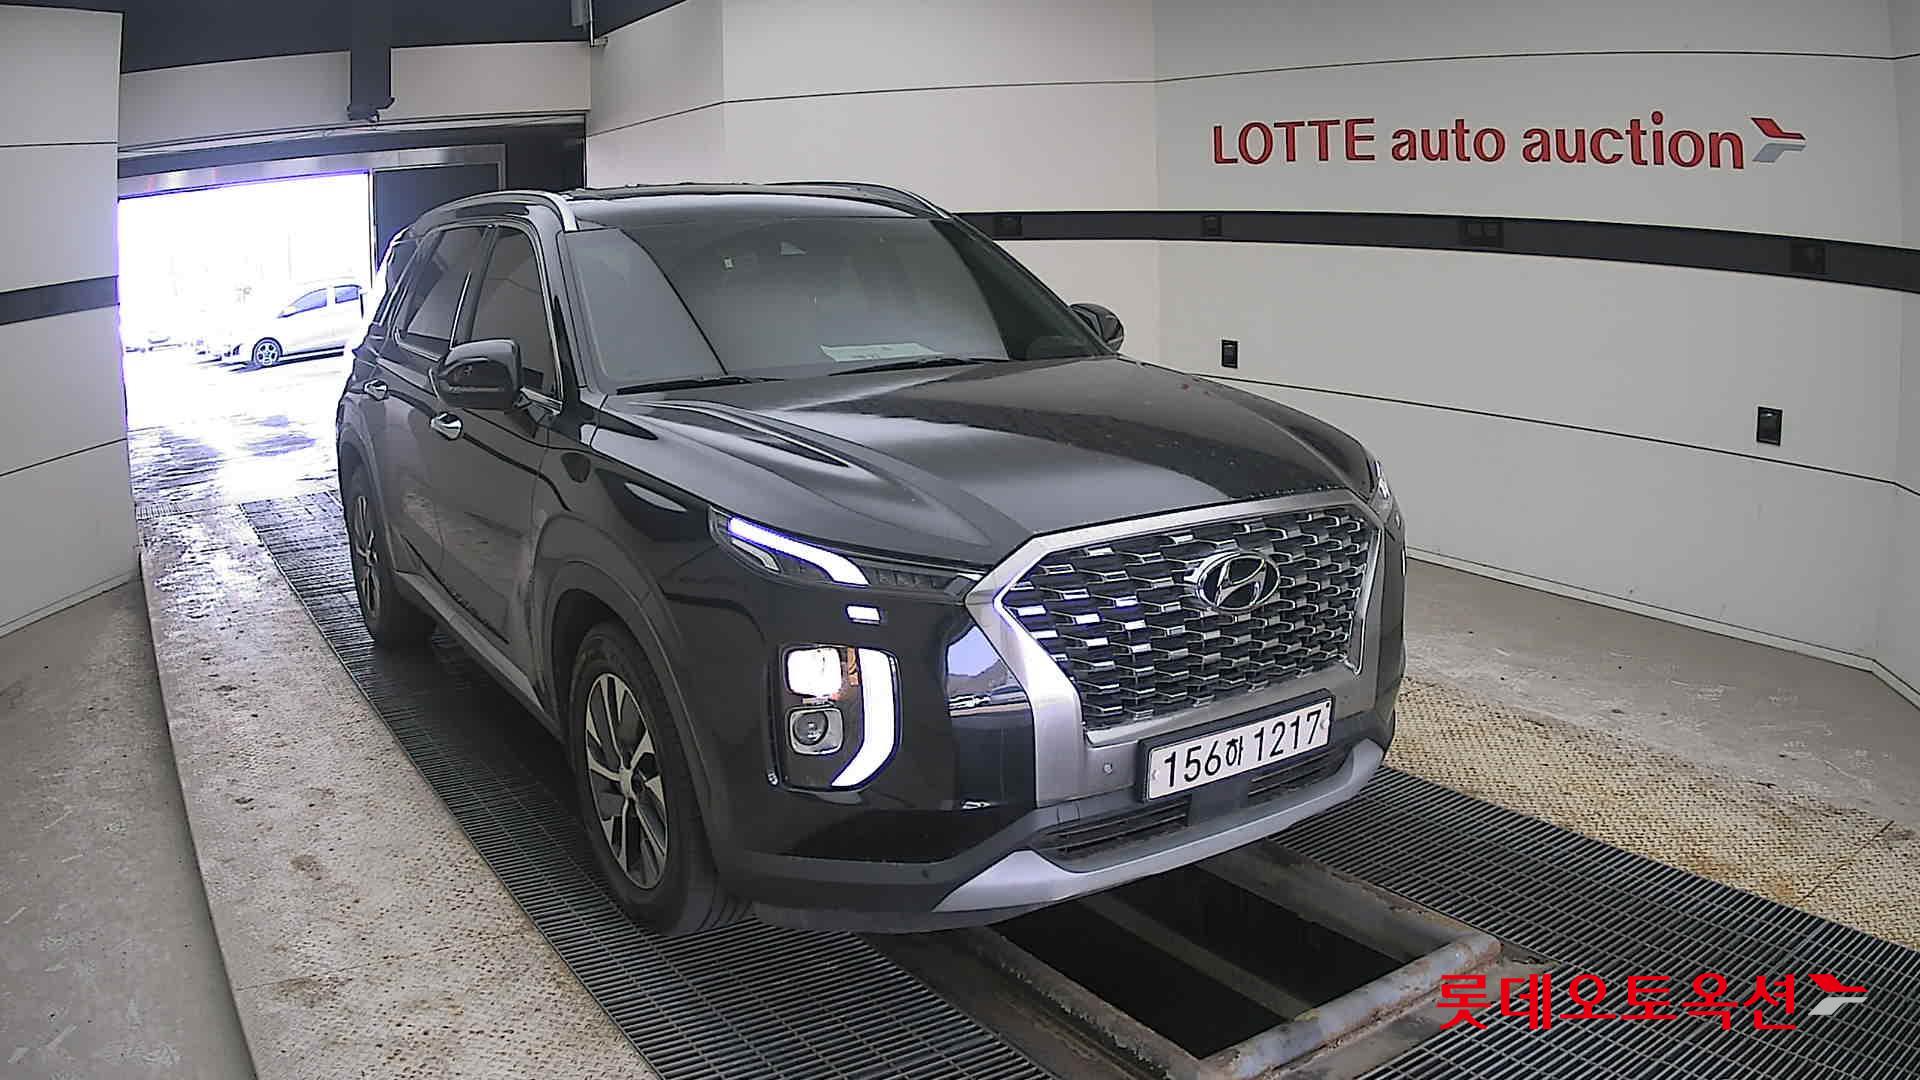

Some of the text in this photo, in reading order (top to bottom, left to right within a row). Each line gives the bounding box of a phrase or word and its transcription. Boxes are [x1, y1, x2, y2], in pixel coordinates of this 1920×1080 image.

[1212, 111, 1745, 170] LOTTE auto auction
[1163, 708, 1322, 788] 156하 1217
